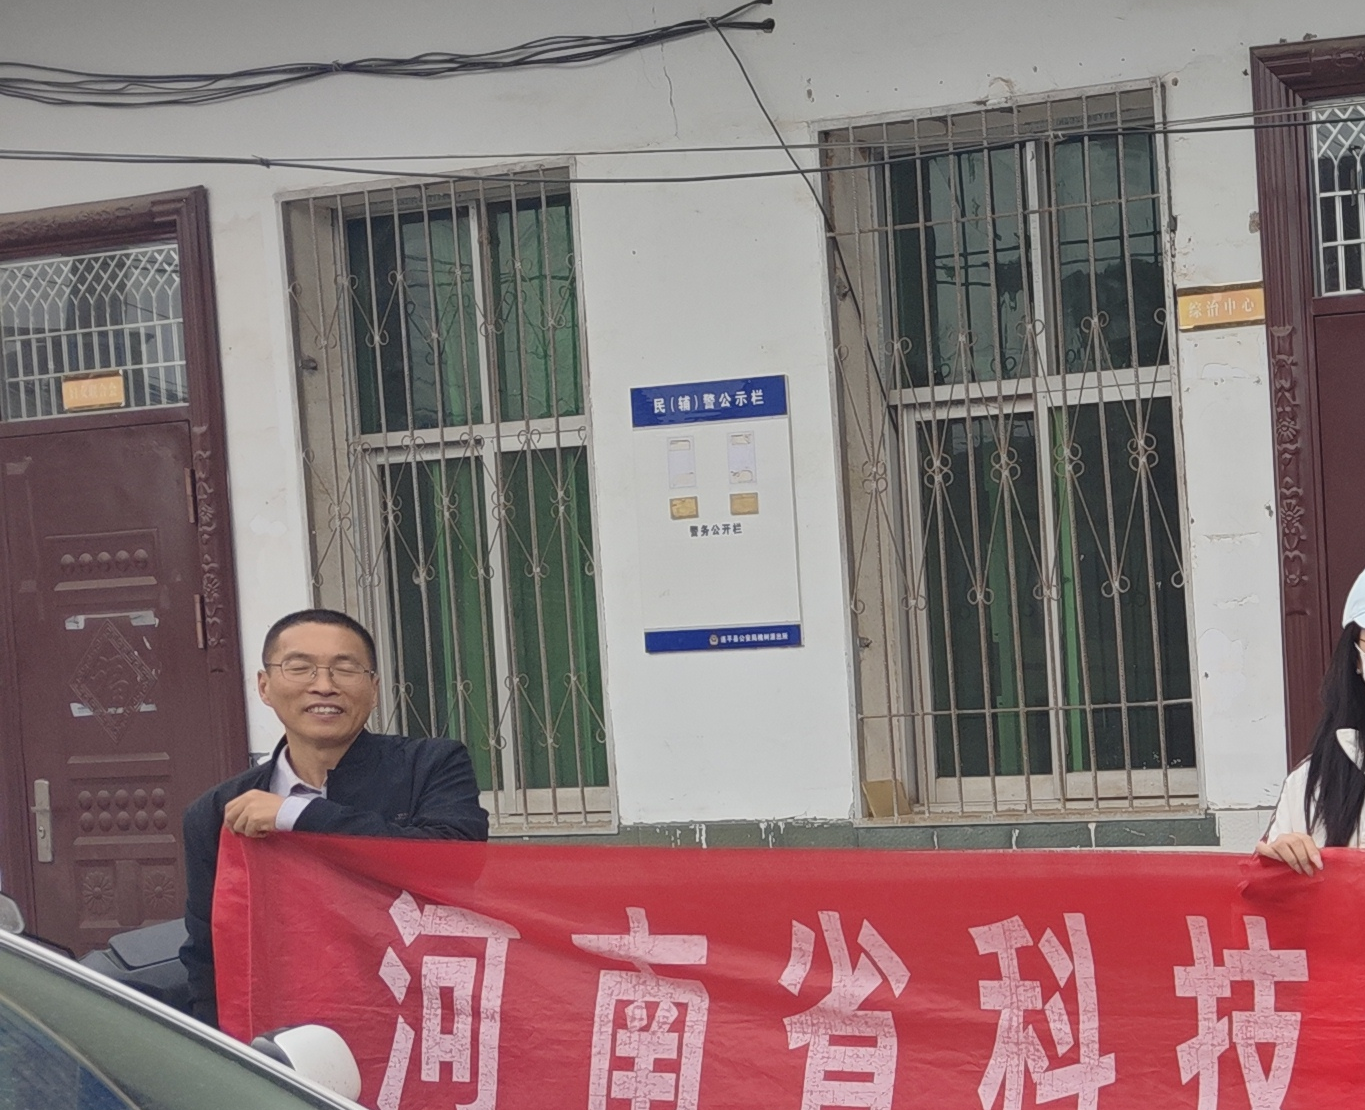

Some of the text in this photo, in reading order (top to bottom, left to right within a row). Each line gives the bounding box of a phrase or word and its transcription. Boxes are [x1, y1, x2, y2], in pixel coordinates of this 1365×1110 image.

[1188, 297, 1255, 319] 综治中心
[689, 522, 743, 538] 警务公开栏
